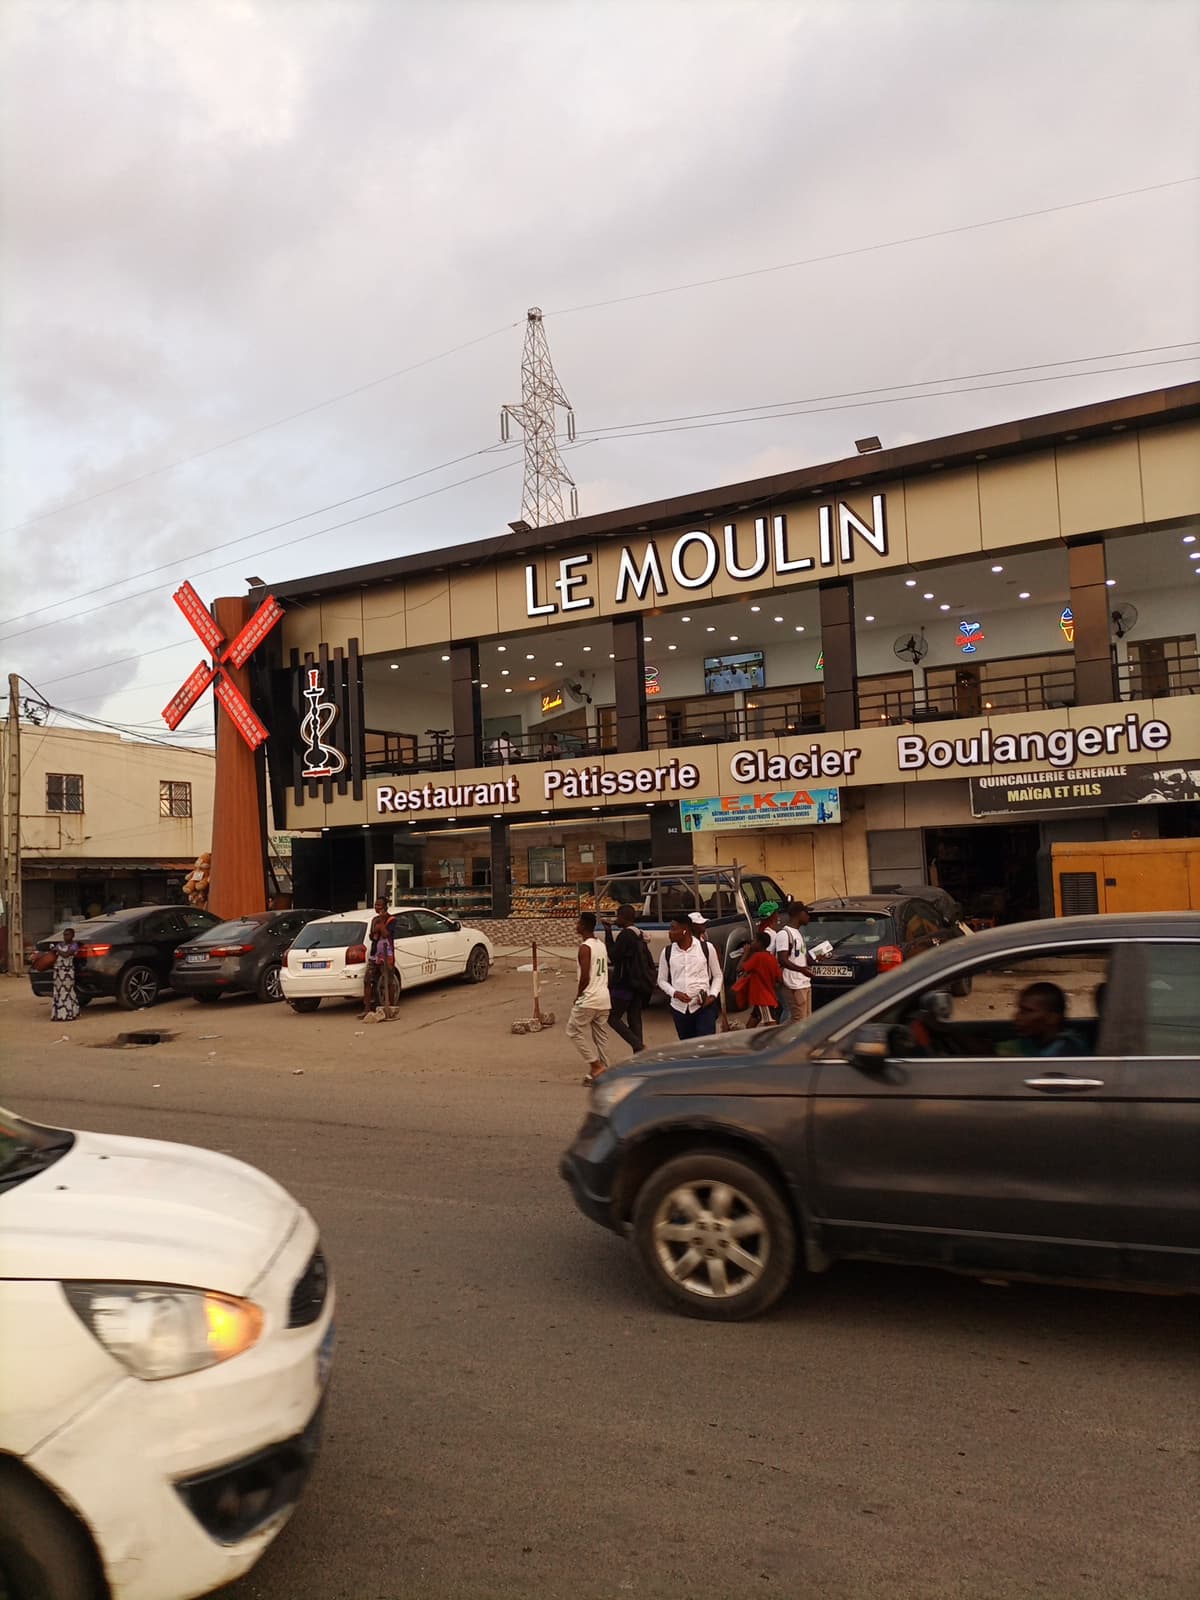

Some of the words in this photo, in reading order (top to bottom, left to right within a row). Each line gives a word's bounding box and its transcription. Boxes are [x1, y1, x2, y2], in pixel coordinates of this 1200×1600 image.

[525, 554, 593, 617] LE
[615, 494, 889, 603] MOULIN
[376, 775, 519, 813] Restaurant
[544, 759, 699, 799] Pâtisserie
[730, 744, 861, 783] Glacier
[896, 714, 1170, 771] Boulangerie
[979, 771, 1065, 789] QUINCAILLERIE
[721, 791, 815, 810] E.K.A
[1007, 786, 1050, 802] MAÏGA
[1054, 786, 1070, 797] ET
[1073, 783, 1101, 796] FILS
